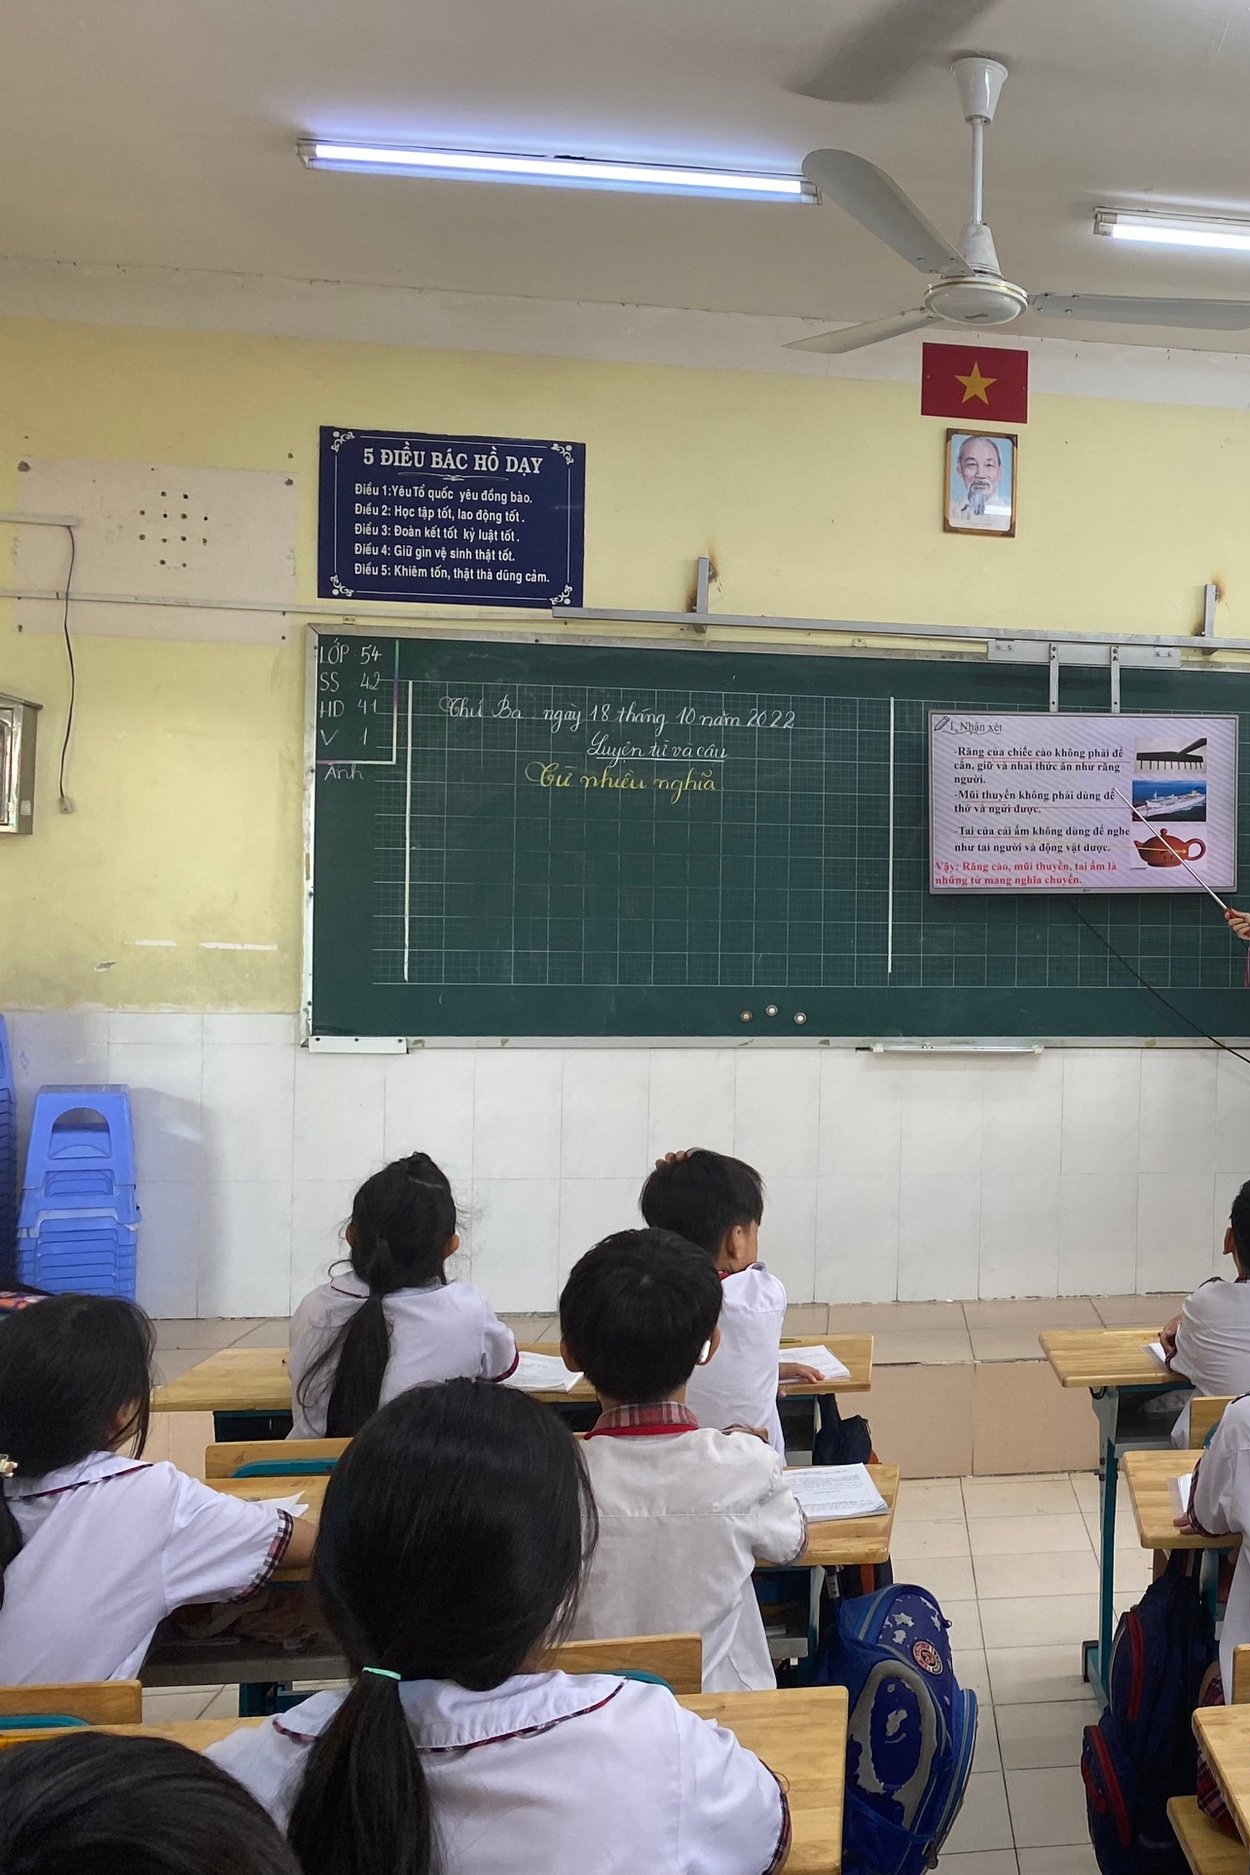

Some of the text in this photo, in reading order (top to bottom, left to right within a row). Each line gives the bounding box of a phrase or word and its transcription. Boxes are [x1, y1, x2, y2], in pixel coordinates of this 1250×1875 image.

[363, 441, 544, 477] 5 ĐIỀU BÁC HỒ DẠY
[354, 481, 379, 496] Điều
[428, 486, 454, 501] quốc
[459, 488, 478, 503] yêu
[480, 488, 508, 505] đồng
[510, 490, 533, 504] bào.
[354, 501, 379, 516] Điều
[381, 504, 392, 517] 2:
[394, 504, 416, 520] Học
[418, 506, 435, 521] tập
[437, 505, 455, 521] tốt,
[457, 508, 474, 520] lao
[475, 509, 503, 525] động
[354, 521, 379, 536] Điều
[381, 524, 392, 536] 3:
[394, 525, 421, 537] Đoàn
[424, 524, 441, 538] kết
[443, 525, 458, 540] tốt
[463, 526, 476, 543] kỷ
[478, 528, 498, 543] luật
[354, 542, 516, 563] Điều 4: Giữ gìn vệ sinh thật tốt.
[354, 561, 550, 585] Điều 5: Khiêm tốn, thật thà dũng cảm.
[319, 637, 350, 665] LỚP
[319, 671, 381, 693] SS 42
[357, 698, 378, 715] 41
[491, 693, 524, 720] Ba
[543, 702, 583, 734] ngày
[589, 703, 611, 722] 18
[614, 700, 668, 738] tháng
[675, 706, 697, 725] 10
[698, 709, 742, 728] năm
[746, 708, 797, 729] 2022
[586, 730, 729, 769] Luyện từ và câu
[579, 767, 648, 790] nhiều
[653, 766, 717, 805] nghĩa
